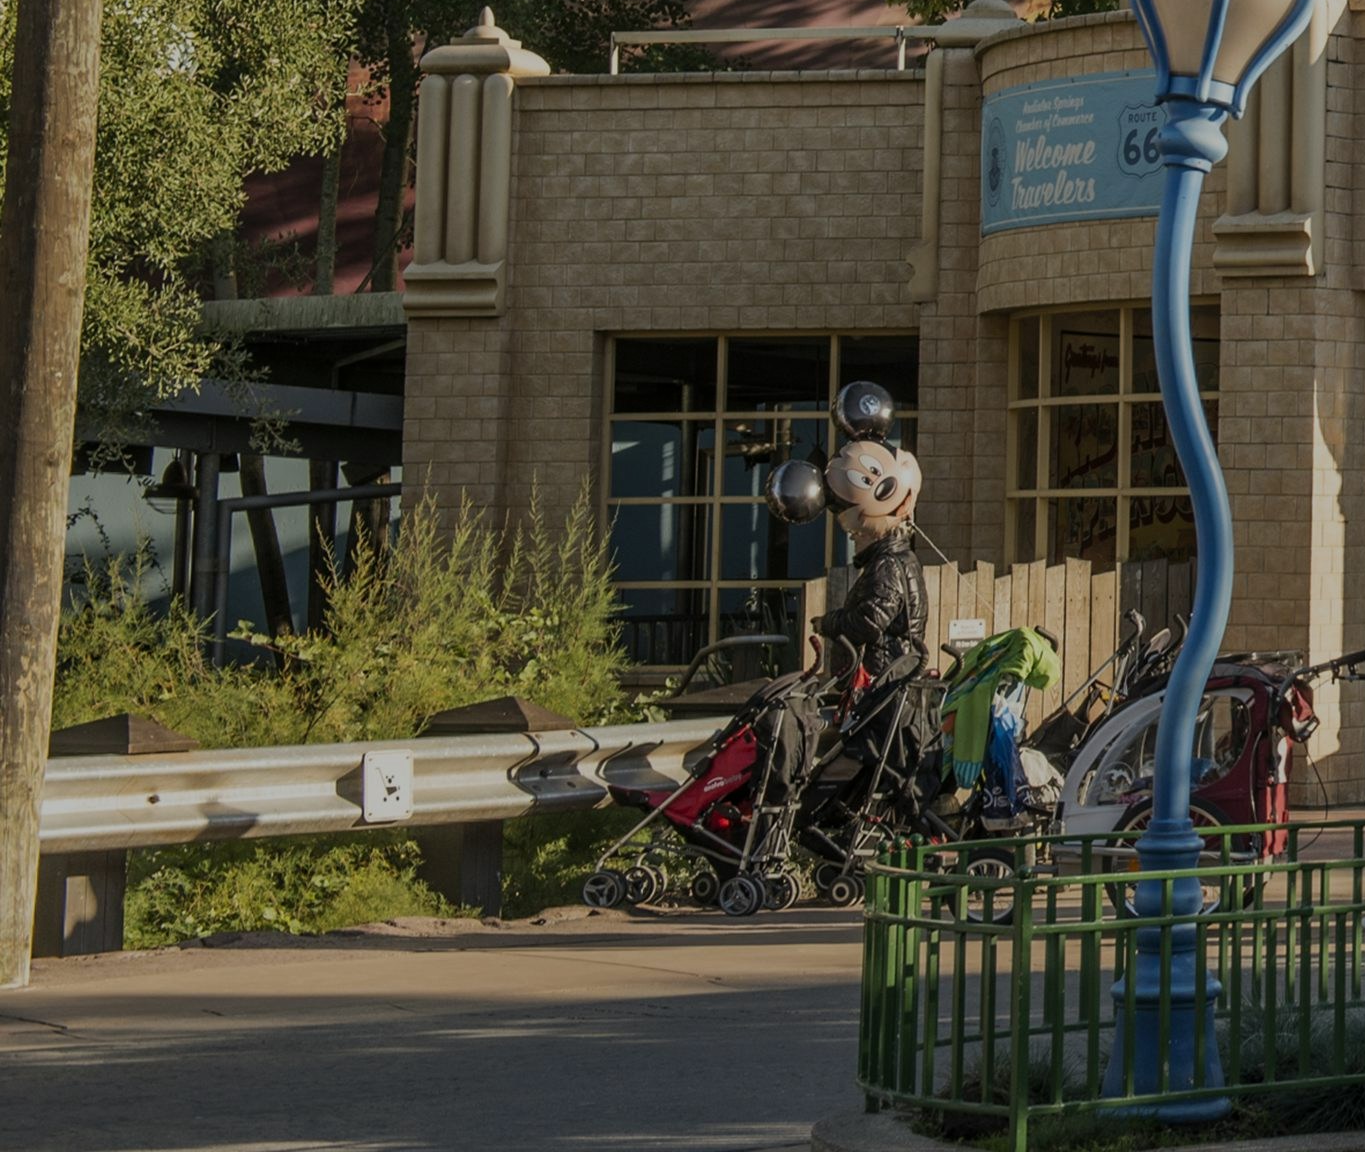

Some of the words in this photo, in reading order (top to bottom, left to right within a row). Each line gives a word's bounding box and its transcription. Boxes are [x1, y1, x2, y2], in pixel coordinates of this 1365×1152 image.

[1128, 112, 1157, 123] ROUTE
[1015, 134, 1096, 173] Welcome
[1123, 126, 1160, 166] 66
[1011, 170, 1095, 210] Travelers
